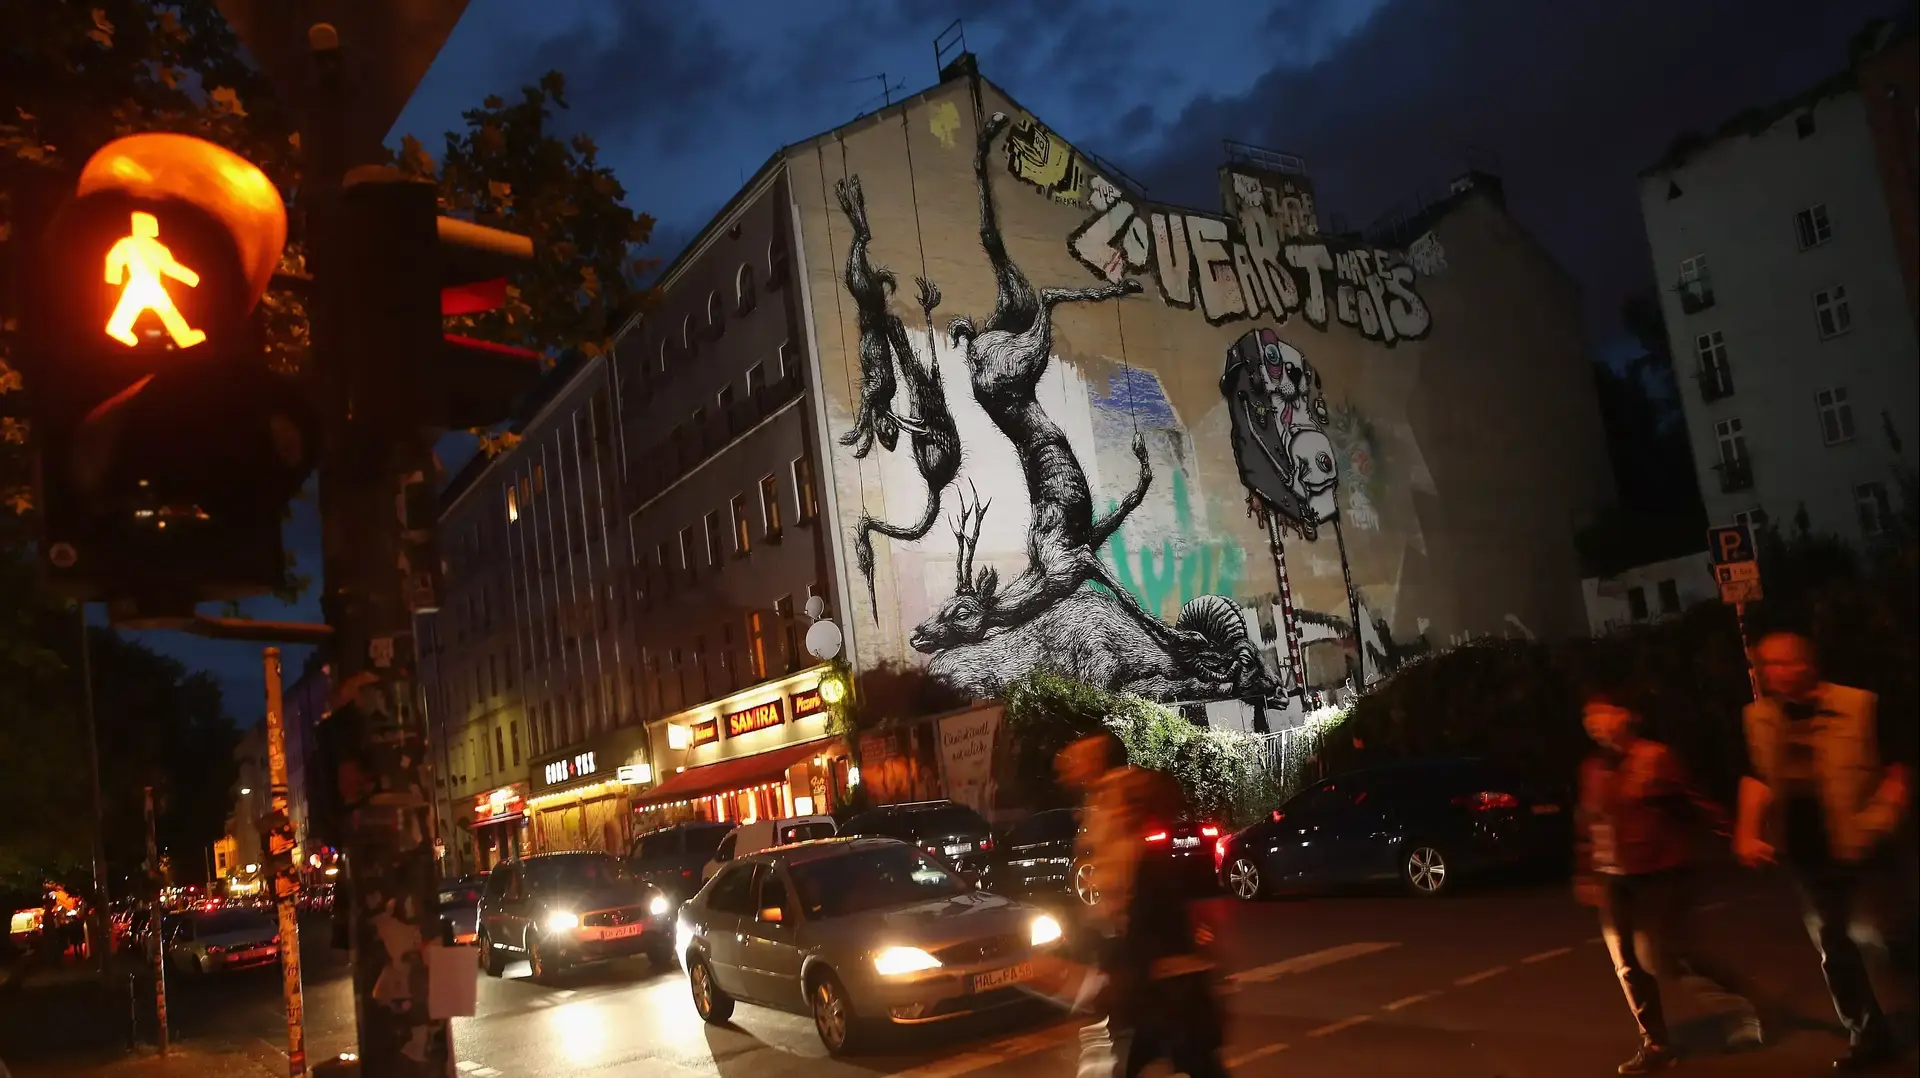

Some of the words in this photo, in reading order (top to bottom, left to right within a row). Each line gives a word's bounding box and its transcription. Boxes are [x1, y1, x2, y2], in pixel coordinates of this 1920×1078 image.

[1072, 200, 1245, 322] LOVE
[1234, 205, 1333, 331] ART
[1335, 248, 1393, 286] HATE
[1337, 266, 1430, 342] COPS
[1720, 532, 1741, 561] P
[730, 703, 779, 735] SAMIRA
